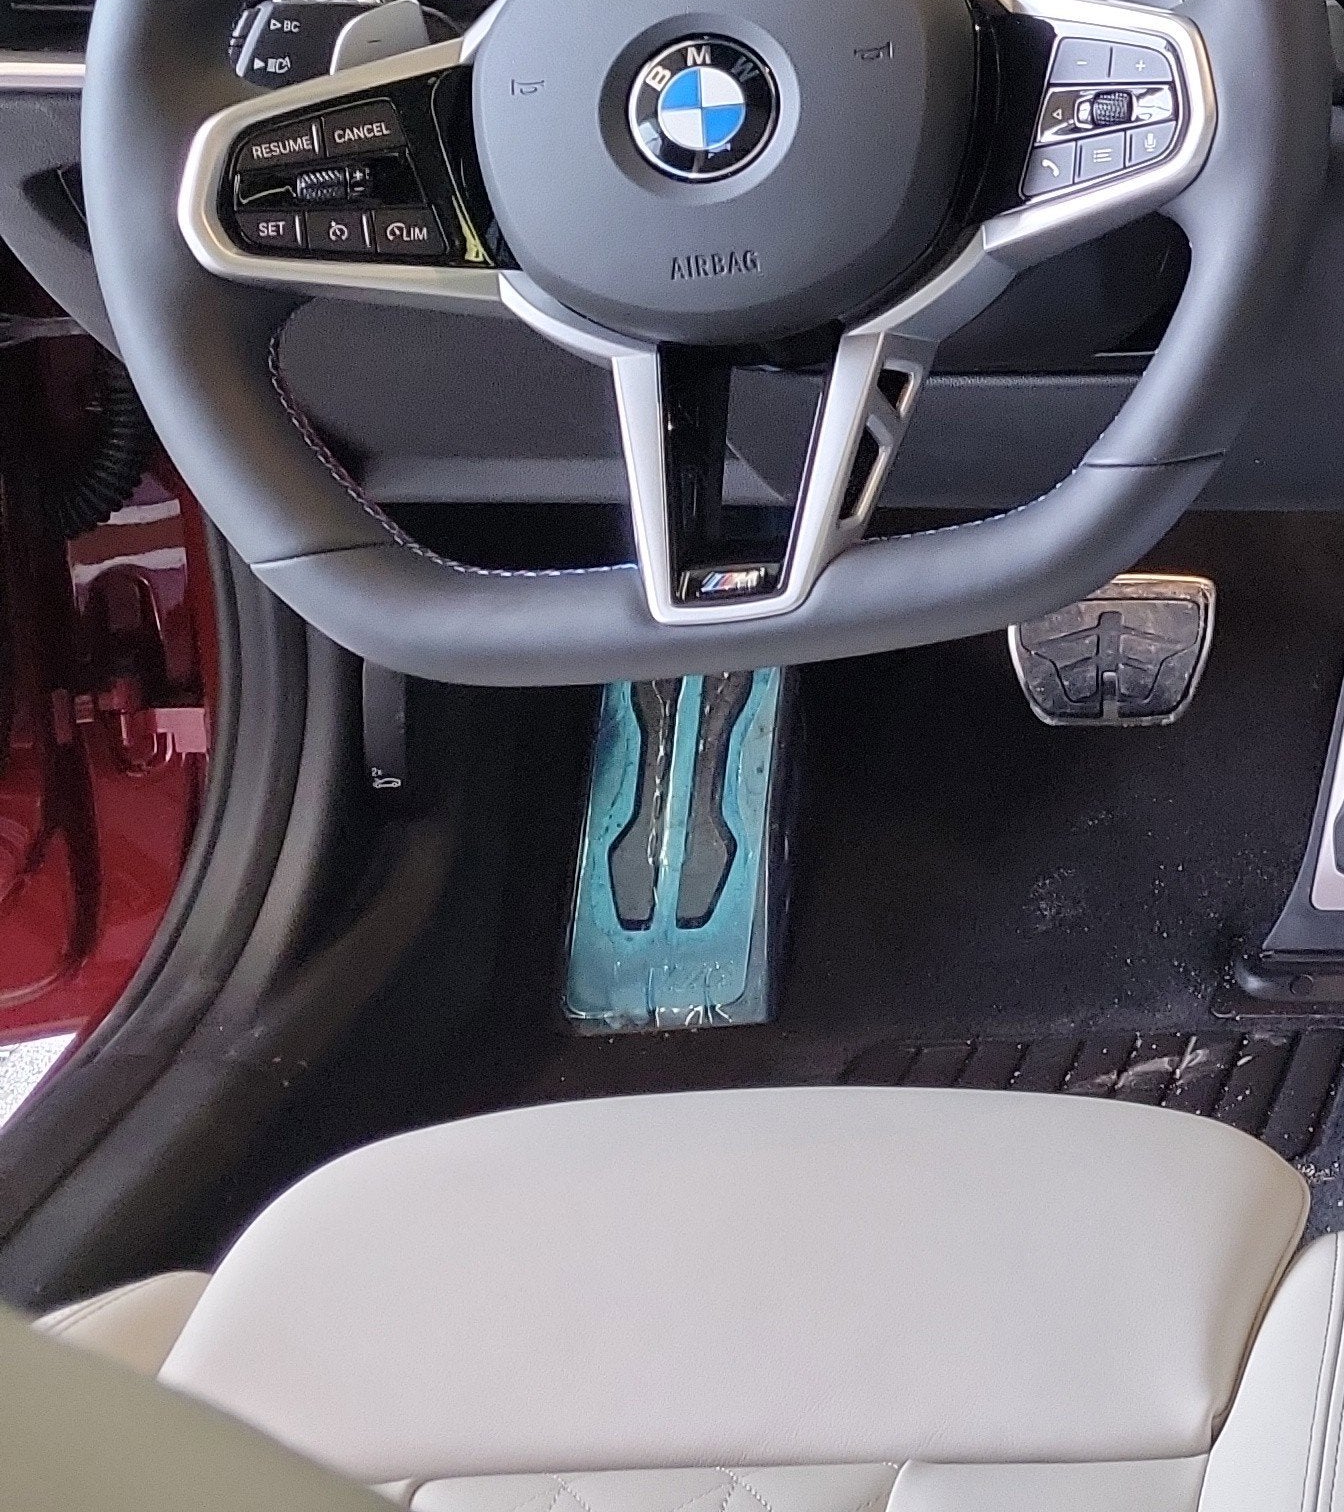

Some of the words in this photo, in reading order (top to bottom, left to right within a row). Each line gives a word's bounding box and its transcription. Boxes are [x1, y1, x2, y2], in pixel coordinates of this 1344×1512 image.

[645, 44, 761, 92] BMW
[334, 121, 391, 144] CANCEL
[252, 136, 312, 160] RESUME
[258, 221, 286, 237] SET
[402, 226, 428, 241] LIM
[670, 250, 762, 282] AIRBAG
